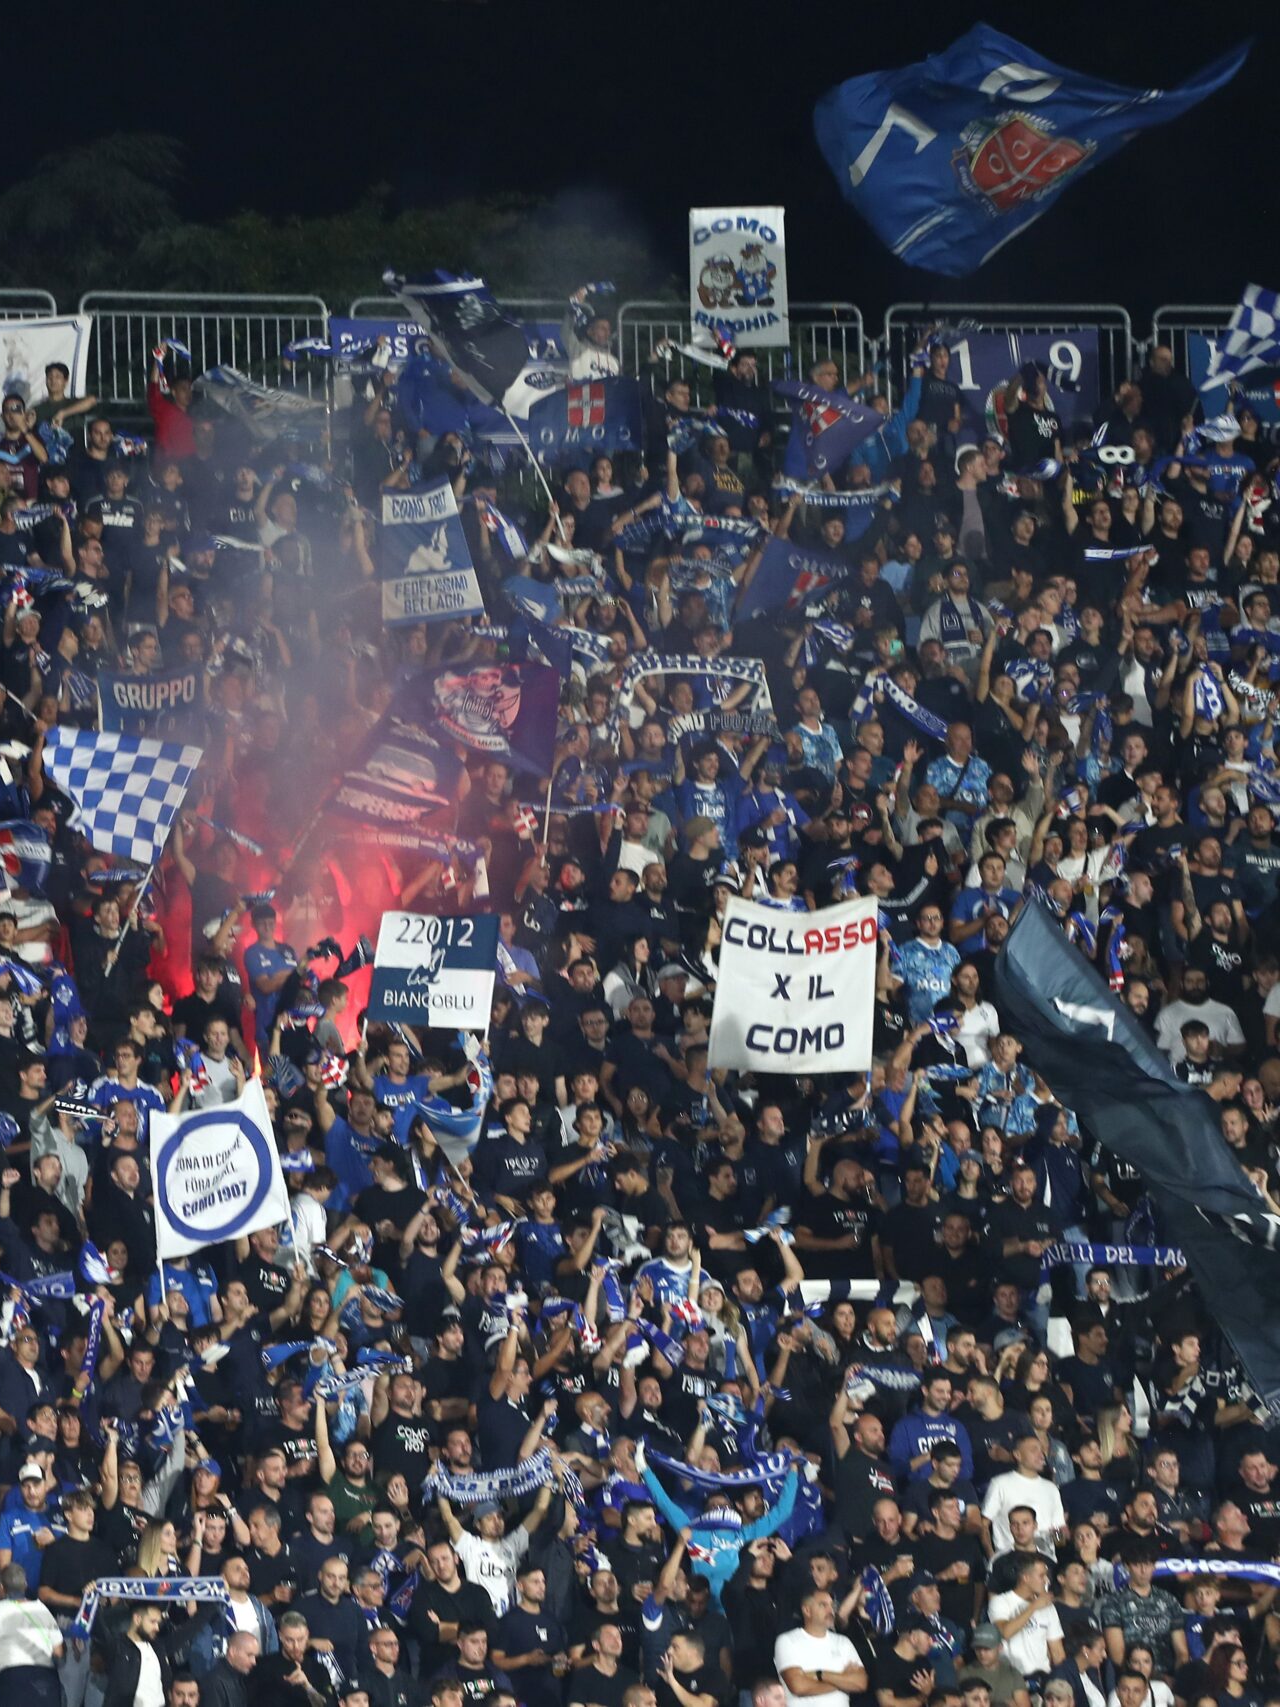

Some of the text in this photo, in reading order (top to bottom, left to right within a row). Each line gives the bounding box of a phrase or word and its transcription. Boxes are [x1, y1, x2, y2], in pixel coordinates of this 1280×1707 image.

[693, 216, 777, 244] COMO
[1049, 340, 1082, 392] 9
[113, 674, 196, 711] GRUPPO
[395, 917, 475, 948] 22012
[724, 916, 879, 956] COLLASSO
[383, 989, 475, 1010] BIANCOBLU
[770, 973, 835, 1001] X IL
[745, 1022, 845, 1054] COMO
[176, 1154, 214, 1172] ZONA DI
[182, 1181, 248, 1217] COMO 1907
[1104, 1245, 1138, 1264] DEL
[1153, 1247, 1187, 1268] LAG
[479, 1561, 517, 1579] Uber
